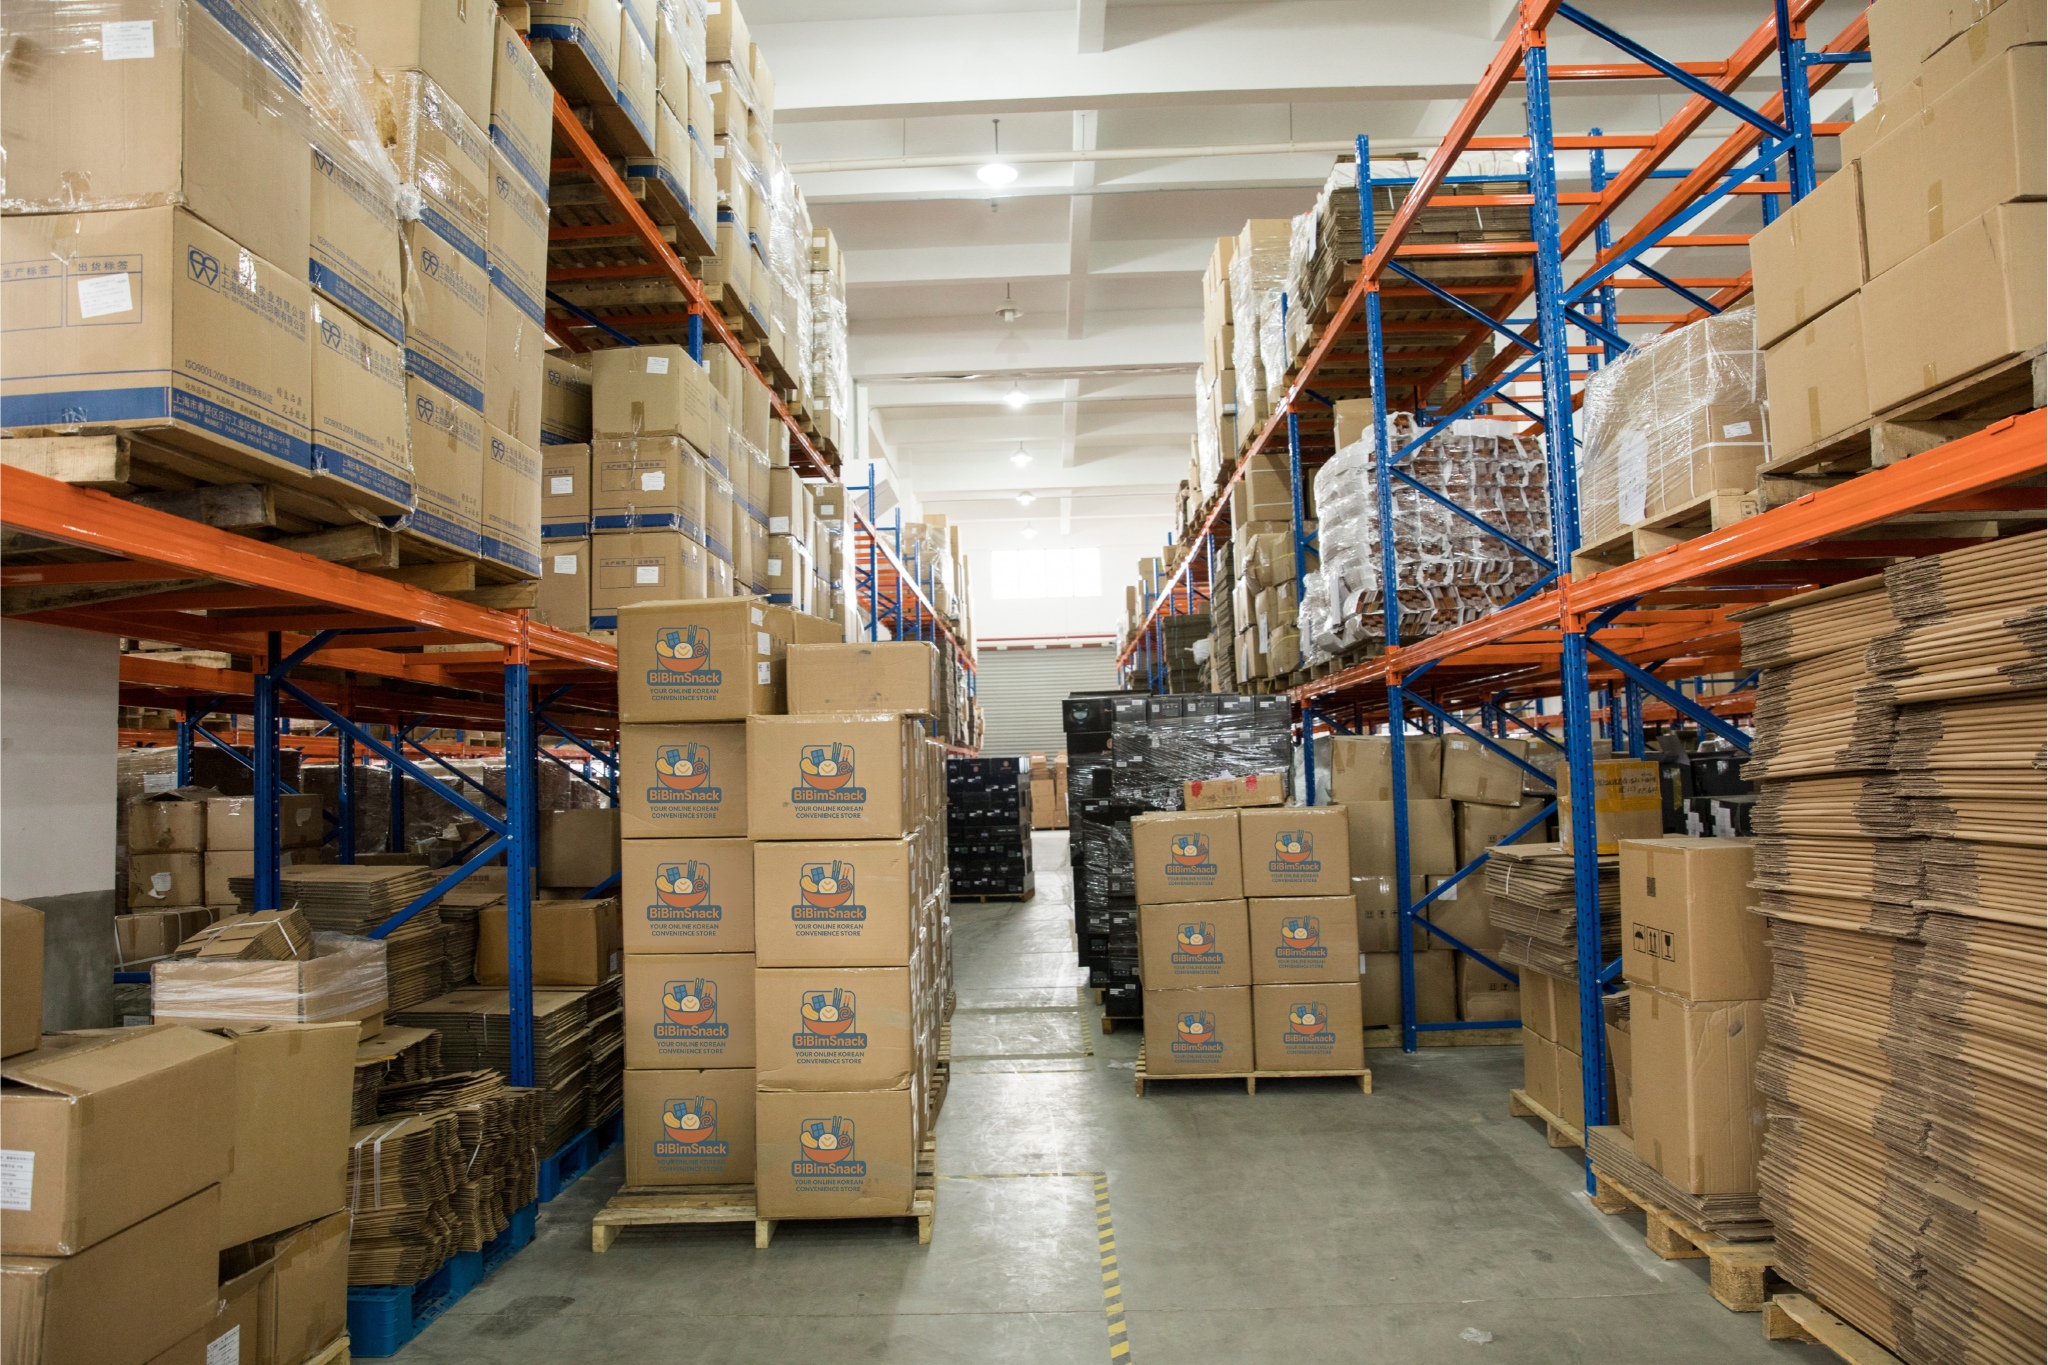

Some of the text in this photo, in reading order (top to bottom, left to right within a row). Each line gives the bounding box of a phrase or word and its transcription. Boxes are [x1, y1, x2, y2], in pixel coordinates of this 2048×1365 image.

[3, 265, 49, 278] 生产标签
[78, 261, 128, 271] 出货标签
[649, 672, 720, 683] BiBimSnack
[649, 790, 720, 801] BiBimSnack
[793, 790, 864, 801] BiBimSnack
[1167, 865, 1216, 873] BiBimSnack
[1271, 862, 1320, 870] BiBimSnack
[649, 907, 720, 918] BiBimSnack
[793, 907, 864, 918] BiBimSnack
[1277, 948, 1326, 956] BiBimSnack
[1173, 954, 1222, 962] BiBimSnack
[656, 1025, 727, 1036] BiBimSnack
[794, 1035, 865, 1046] BiBimSnack
[1285, 1034, 1334, 1042] BiBimSnack
[1173, 1043, 1222, 1051] BiBimSnack
[656, 1143, 727, 1154] BiBimSnack
[793, 1163, 864, 1174] BiBimSnack
